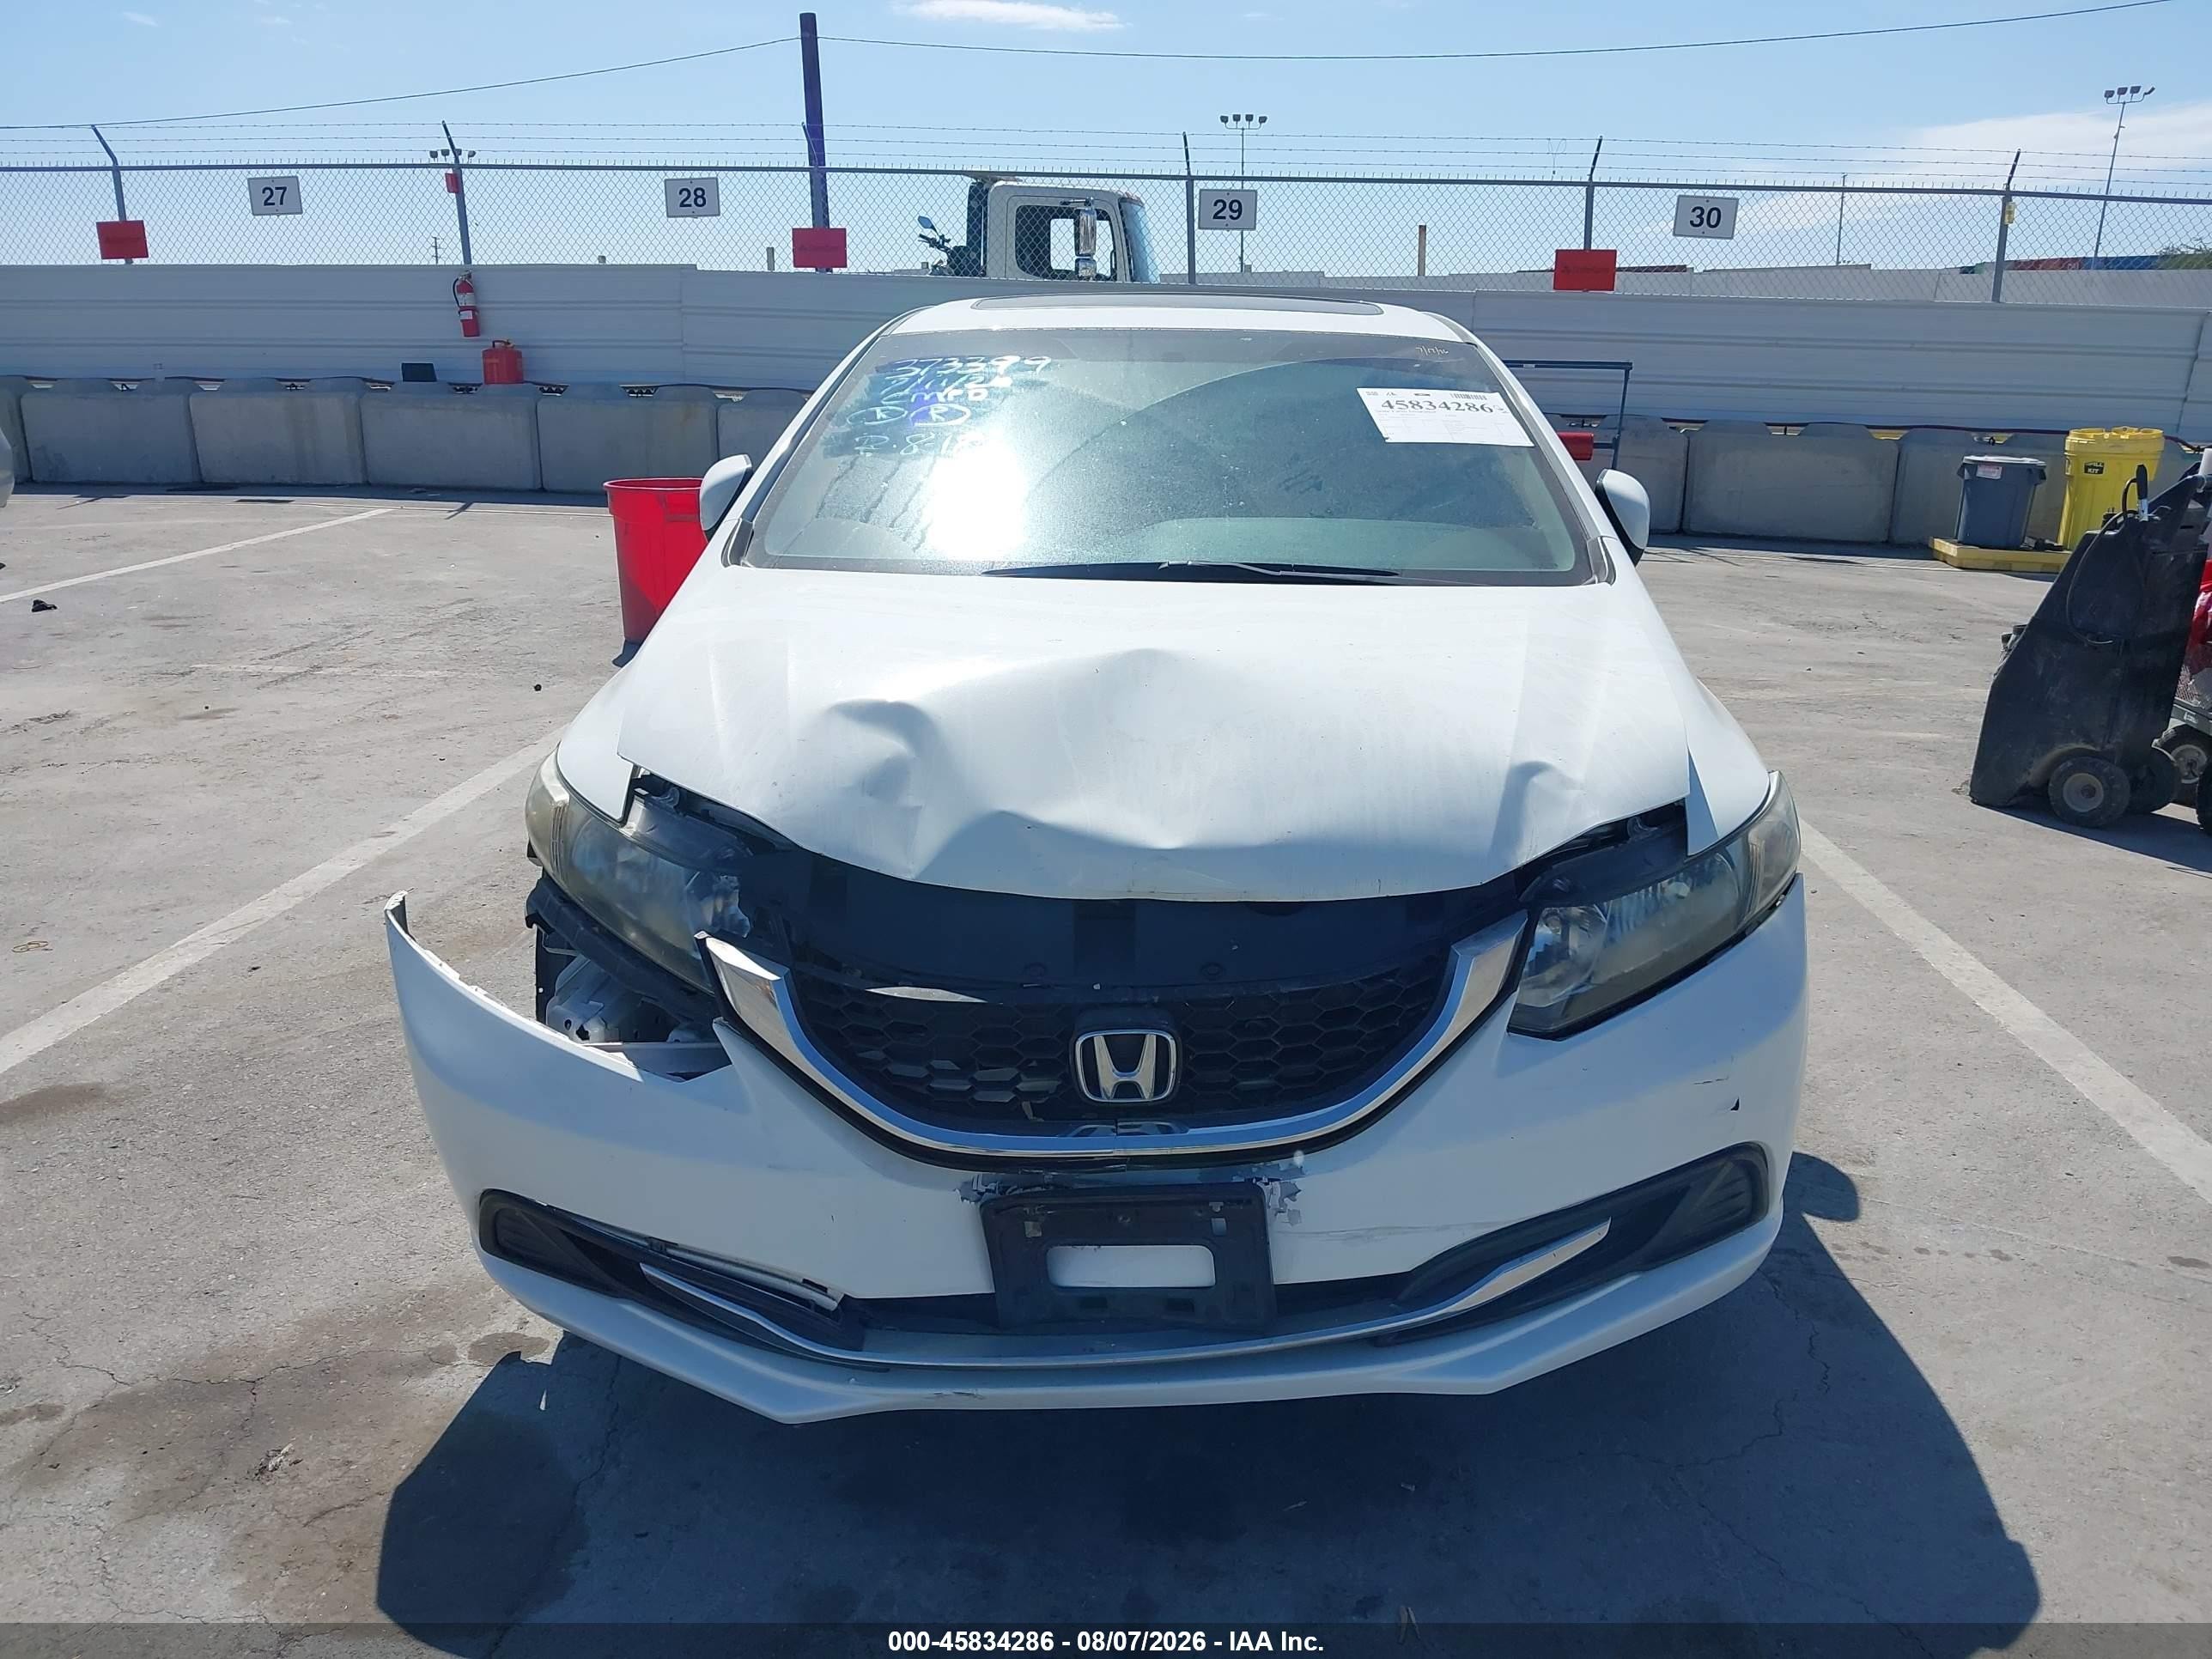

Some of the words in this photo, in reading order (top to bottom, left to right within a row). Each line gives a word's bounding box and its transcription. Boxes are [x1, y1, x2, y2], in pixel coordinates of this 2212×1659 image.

[262, 186, 288, 206] 27
[678, 187, 707, 208] 28
[1212, 199, 1243, 221] 29
[1689, 206, 1722, 228] 30
[1381, 399, 1494, 413] 45834286
